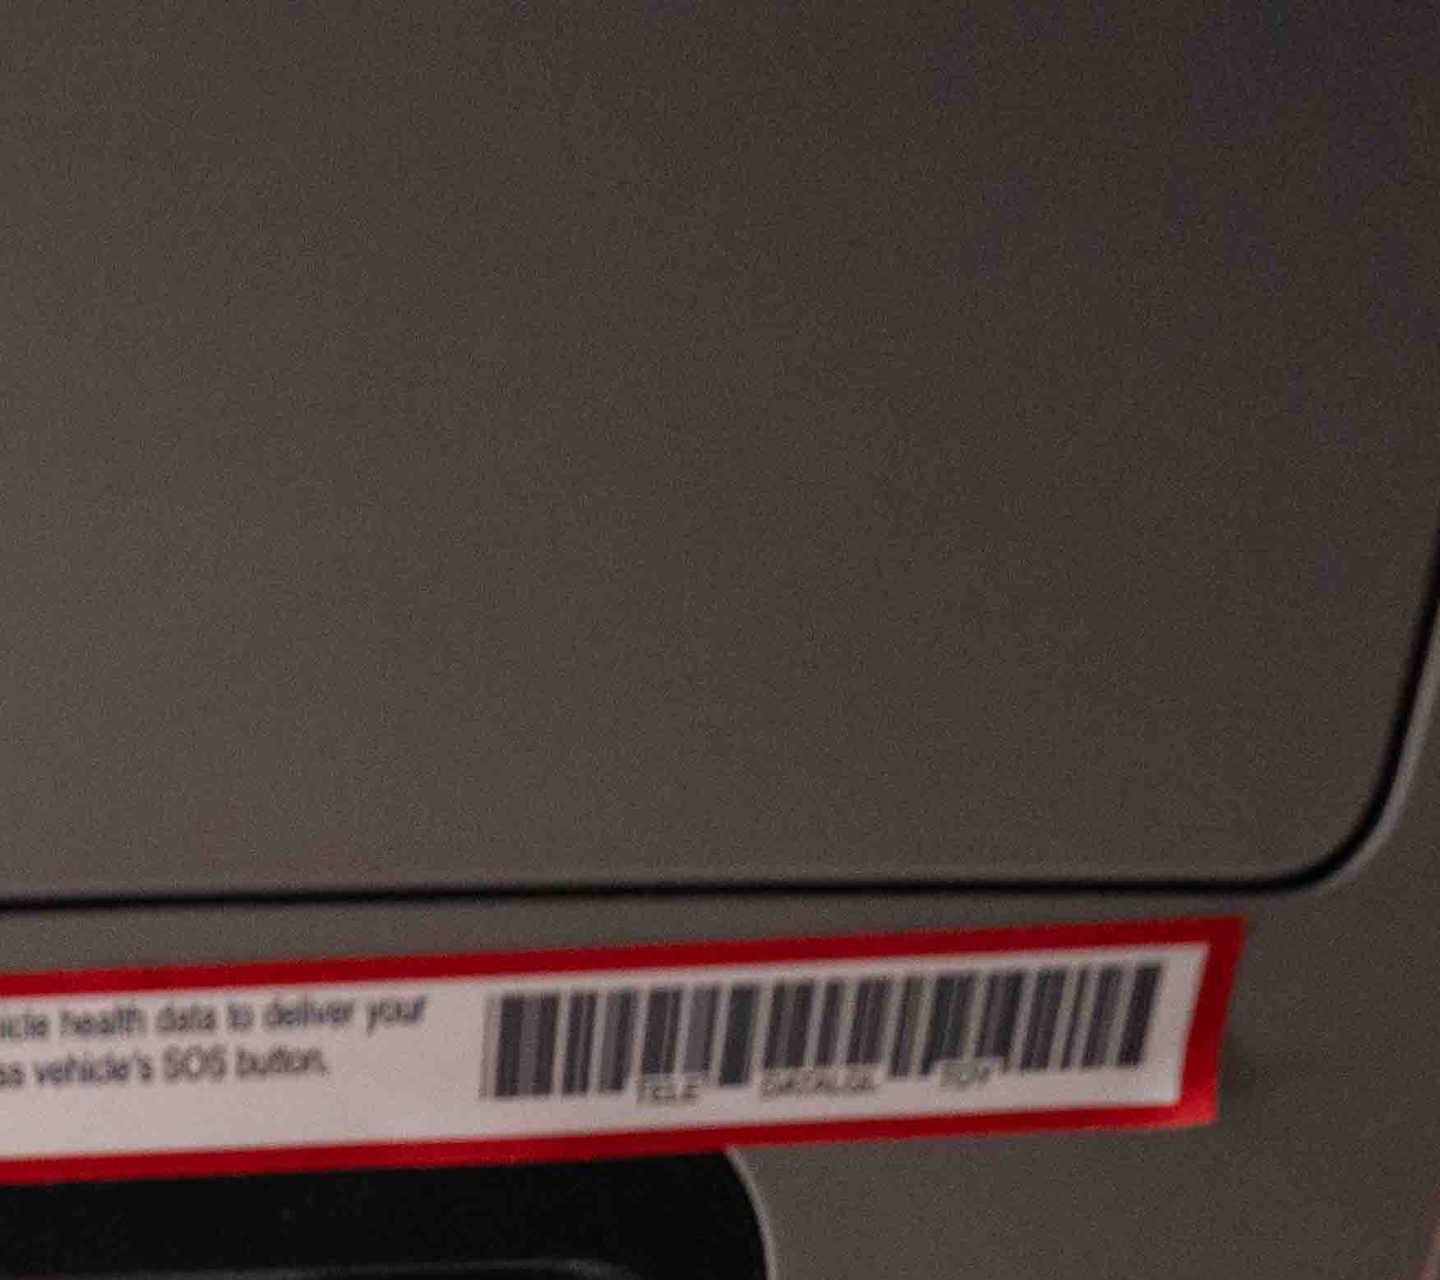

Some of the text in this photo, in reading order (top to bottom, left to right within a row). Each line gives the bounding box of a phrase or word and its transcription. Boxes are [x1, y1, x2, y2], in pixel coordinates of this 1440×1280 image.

[60, 1003, 144, 1037] health
[156, 1003, 218, 1034] data
[228, 1001, 256, 1031] to
[264, 996, 354, 1029] deliver
[367, 999, 426, 1036] your
[162, 1045, 226, 1082] SOS
